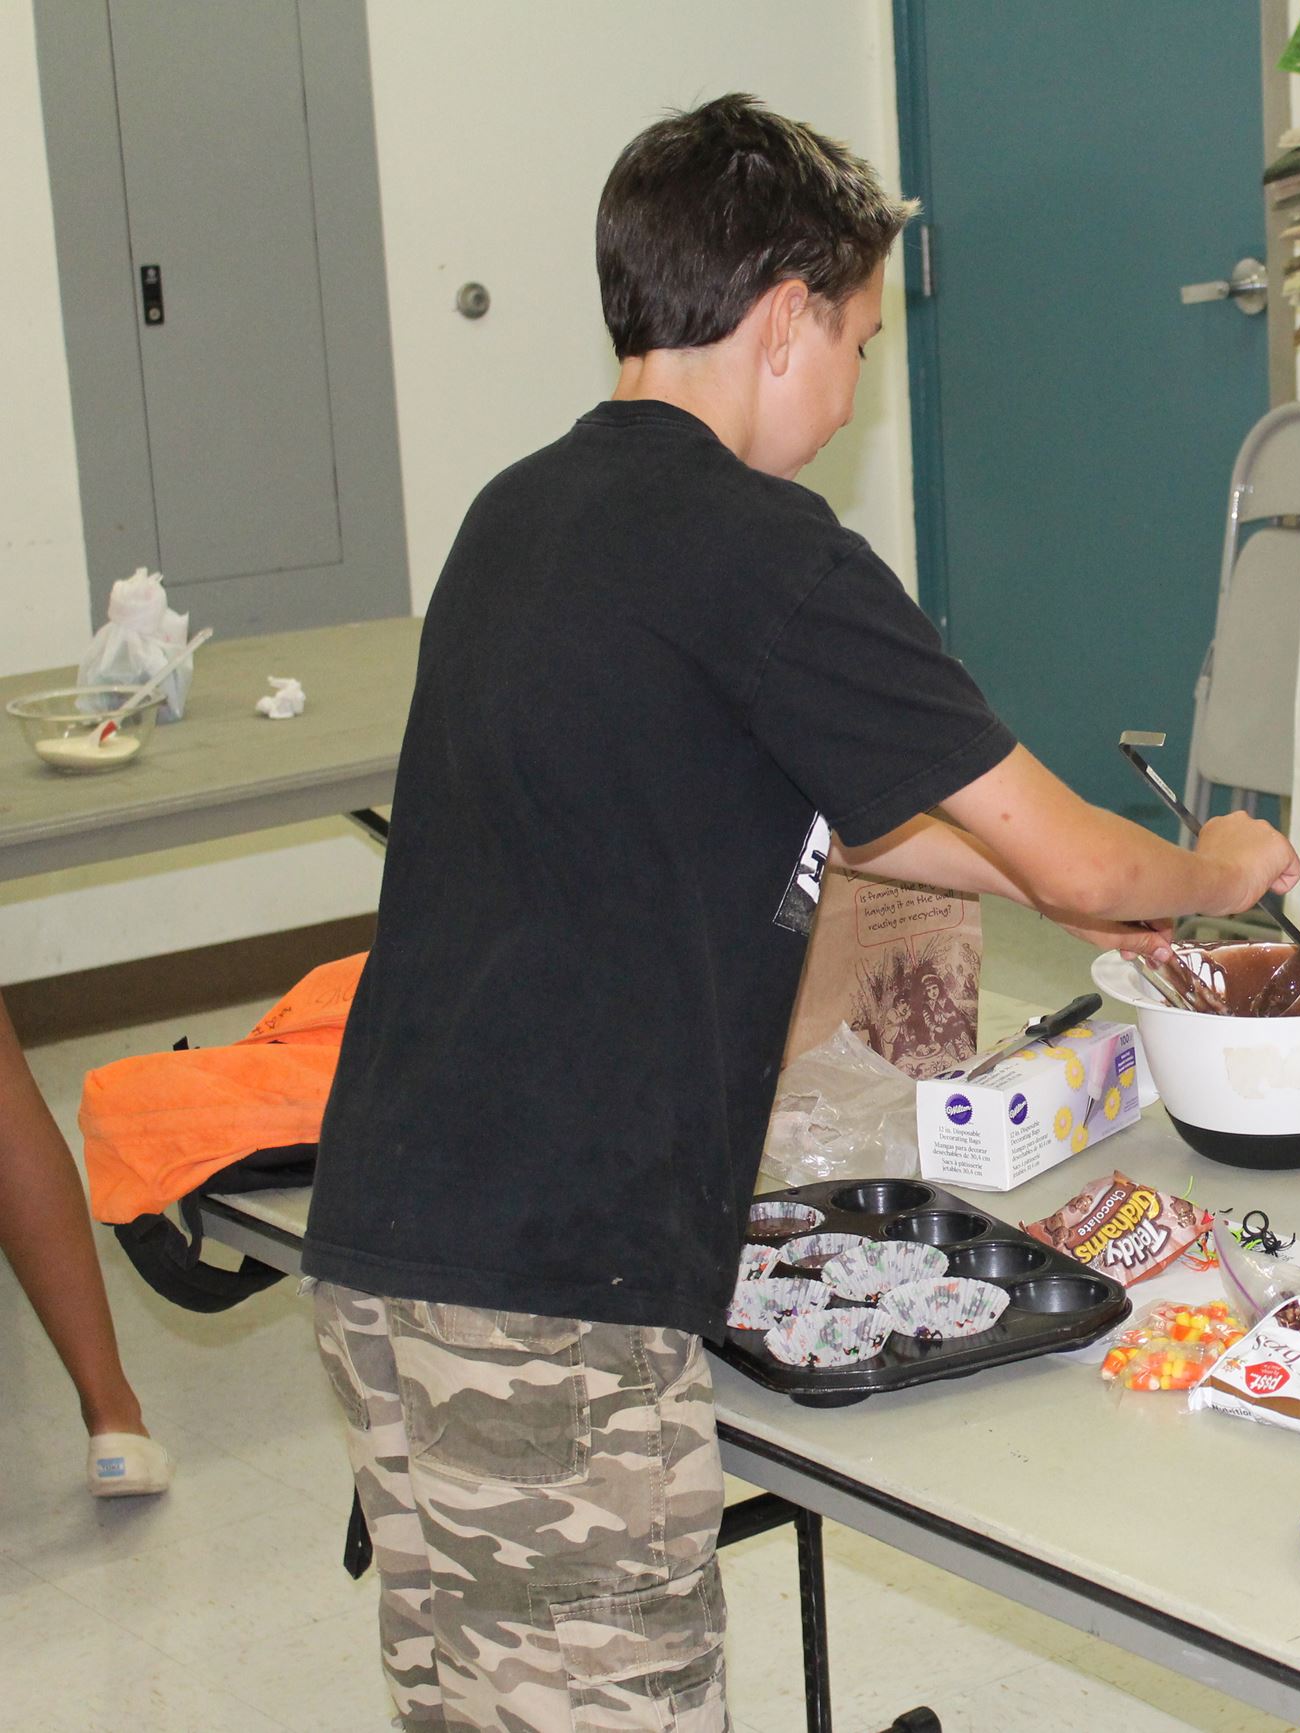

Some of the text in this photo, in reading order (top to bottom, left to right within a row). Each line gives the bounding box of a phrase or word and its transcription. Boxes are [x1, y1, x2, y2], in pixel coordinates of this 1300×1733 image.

[864, 903, 895, 917] hanging
[897, 900, 904, 909] it
[916, 894, 933, 904] the
[935, 889, 954, 901] wall
[867, 887, 898, 902] framing
[868, 918, 897, 931] reusing
[908, 904, 952, 921] recycling?
[945, 1104, 972, 1116] Wilton
[1009, 1100, 1027, 1119] Wilton
[940, 1133, 968, 1142] Decorating
[1078, 1190, 1126, 1236] Chocolate
[1073, 1190, 1161, 1264] Grahams
[1106, 1218, 1169, 1267] Teddy
